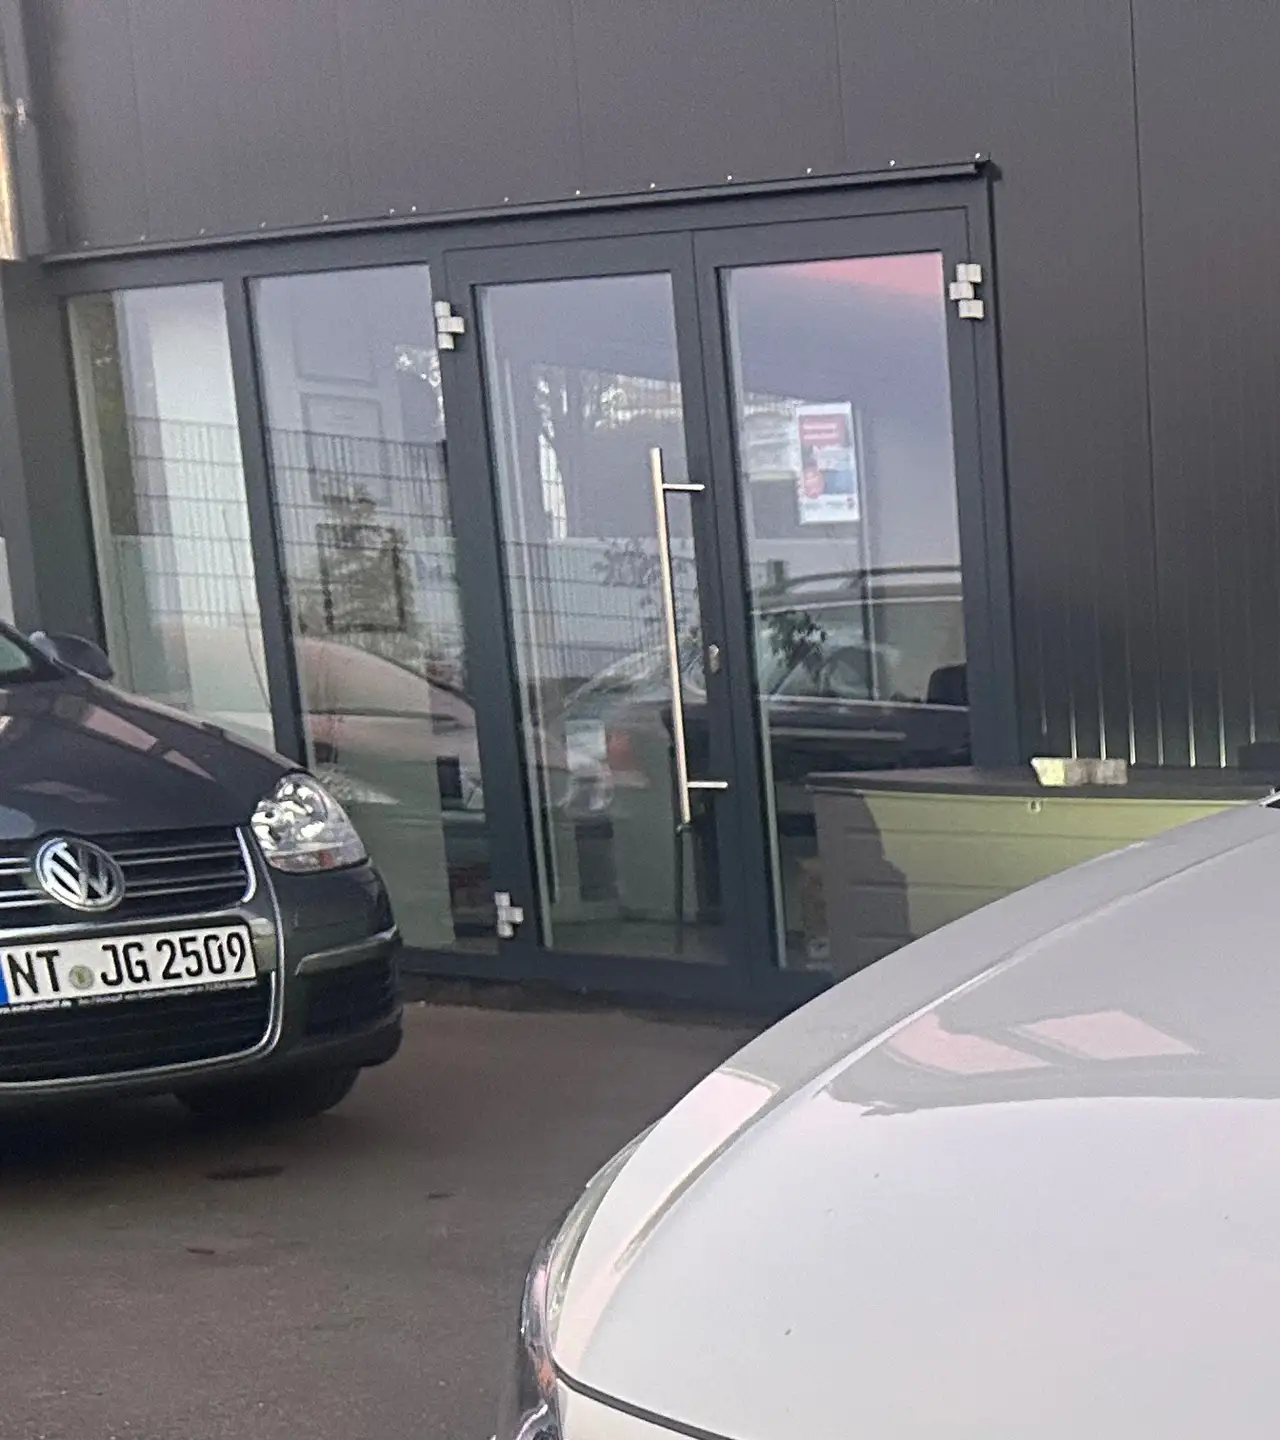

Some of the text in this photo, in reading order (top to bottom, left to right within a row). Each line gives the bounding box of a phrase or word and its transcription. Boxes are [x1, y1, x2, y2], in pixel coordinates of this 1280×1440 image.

[6, 931, 247, 997] NT JG 2509
